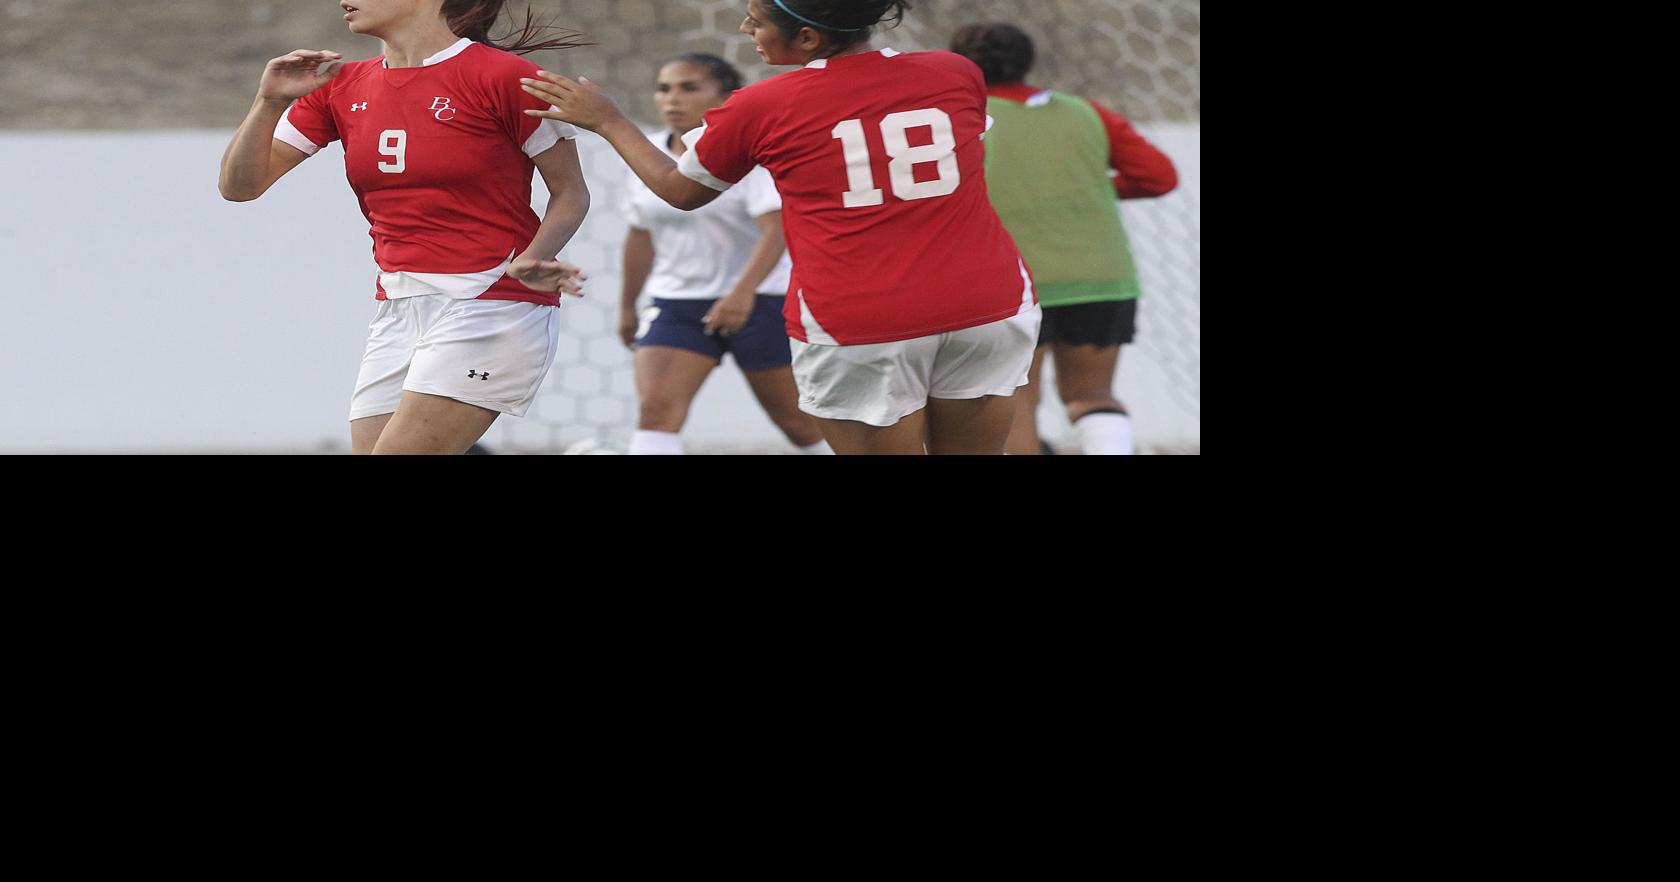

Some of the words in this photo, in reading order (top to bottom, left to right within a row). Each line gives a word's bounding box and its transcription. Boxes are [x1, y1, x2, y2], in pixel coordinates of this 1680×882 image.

[428, 96, 456, 121] BC
[377, 129, 407, 174] 9
[831, 107, 961, 208] 18
